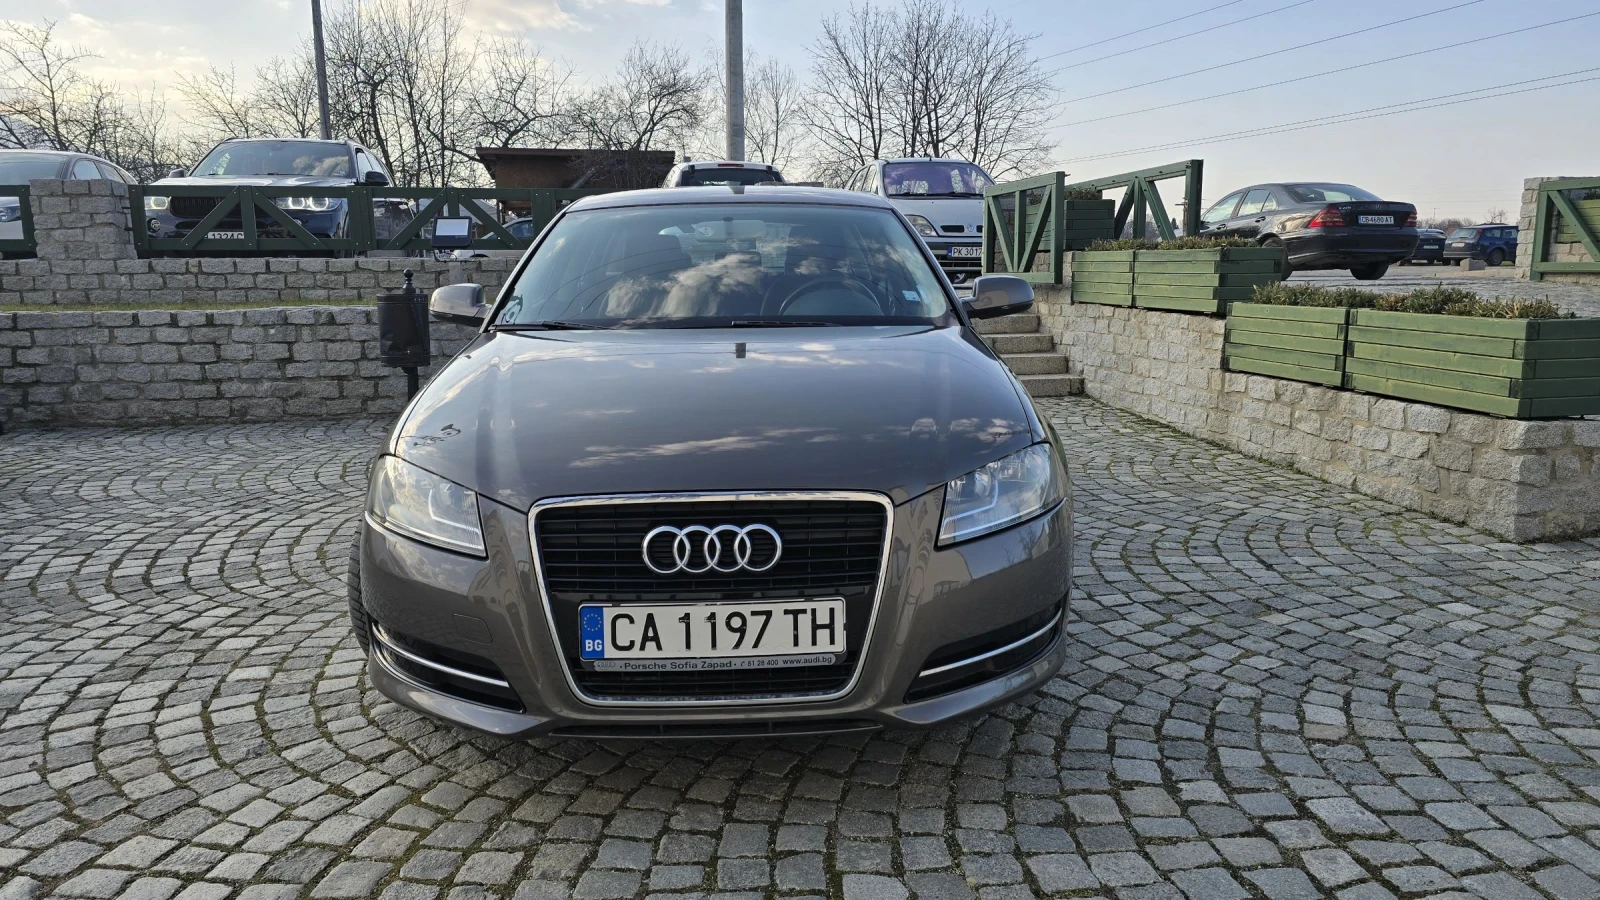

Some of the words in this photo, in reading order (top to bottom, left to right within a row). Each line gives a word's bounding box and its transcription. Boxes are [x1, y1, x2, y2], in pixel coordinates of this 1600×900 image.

[953, 247, 963, 256] PK
[964, 247, 982, 256] 3017
[610, 612, 663, 651] CA
[678, 610, 773, 651] 1197
[783, 607, 836, 648] TH
[585, 639, 603, 652] BG
[624, 662, 667, 670] Porsche
[670, 661, 698, 669] Sofia
[701, 660, 732, 669] Zapad
[767, 658, 779, 666] 400
[782, 655, 832, 665] www.audi.bg
